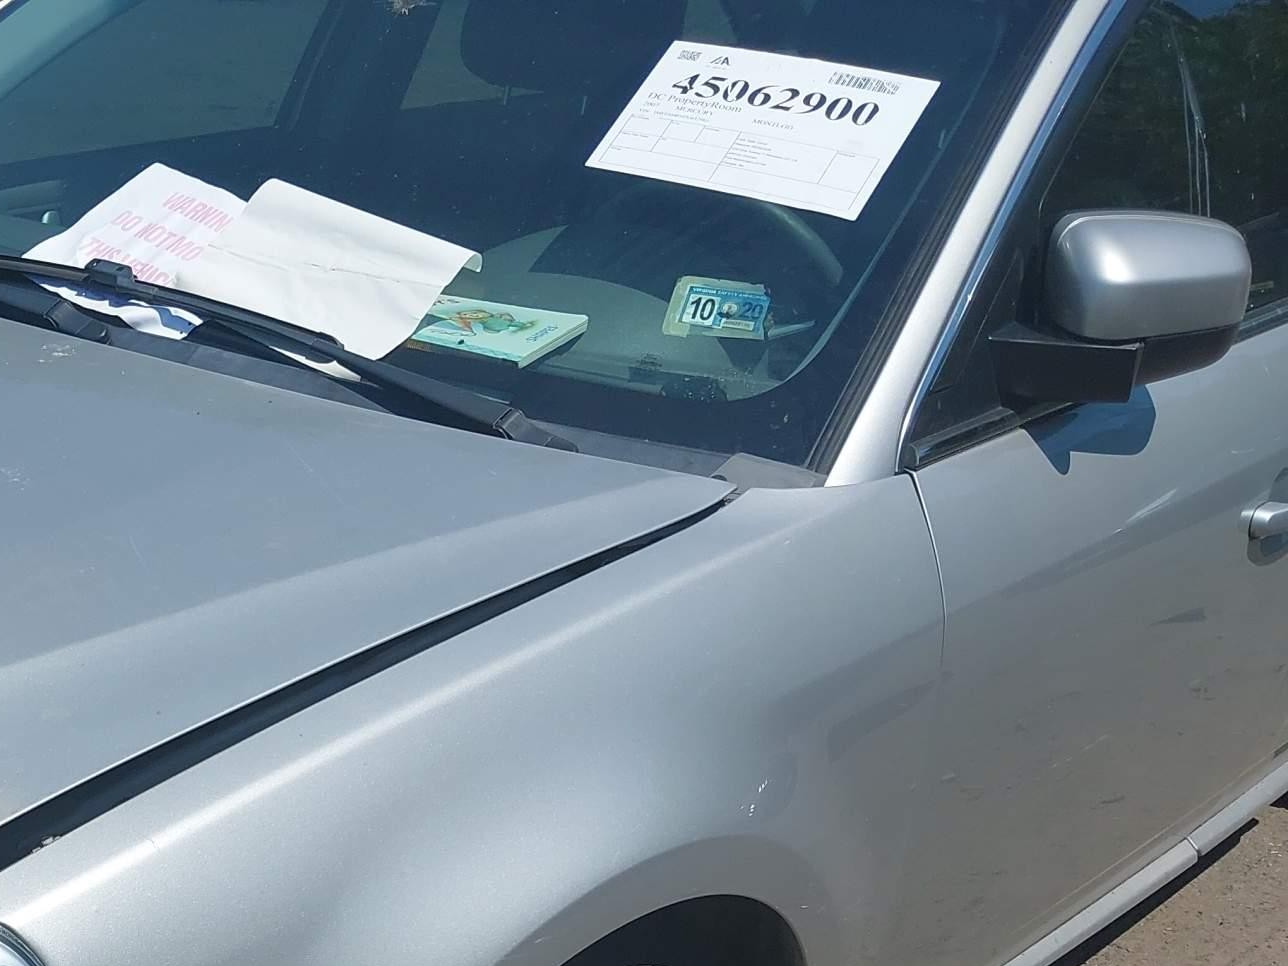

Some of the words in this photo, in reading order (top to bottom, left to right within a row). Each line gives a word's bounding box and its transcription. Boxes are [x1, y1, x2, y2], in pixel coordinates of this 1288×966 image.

[668, 94, 743, 113] PropertyRoom
[671, 72, 881, 127] 45062900
[110, 209, 144, 232] DO
[133, 222, 178, 248] NOT
[162, 191, 234, 233] WARNIN
[690, 296, 716, 321] 10
[740, 301, 764, 319] 20
